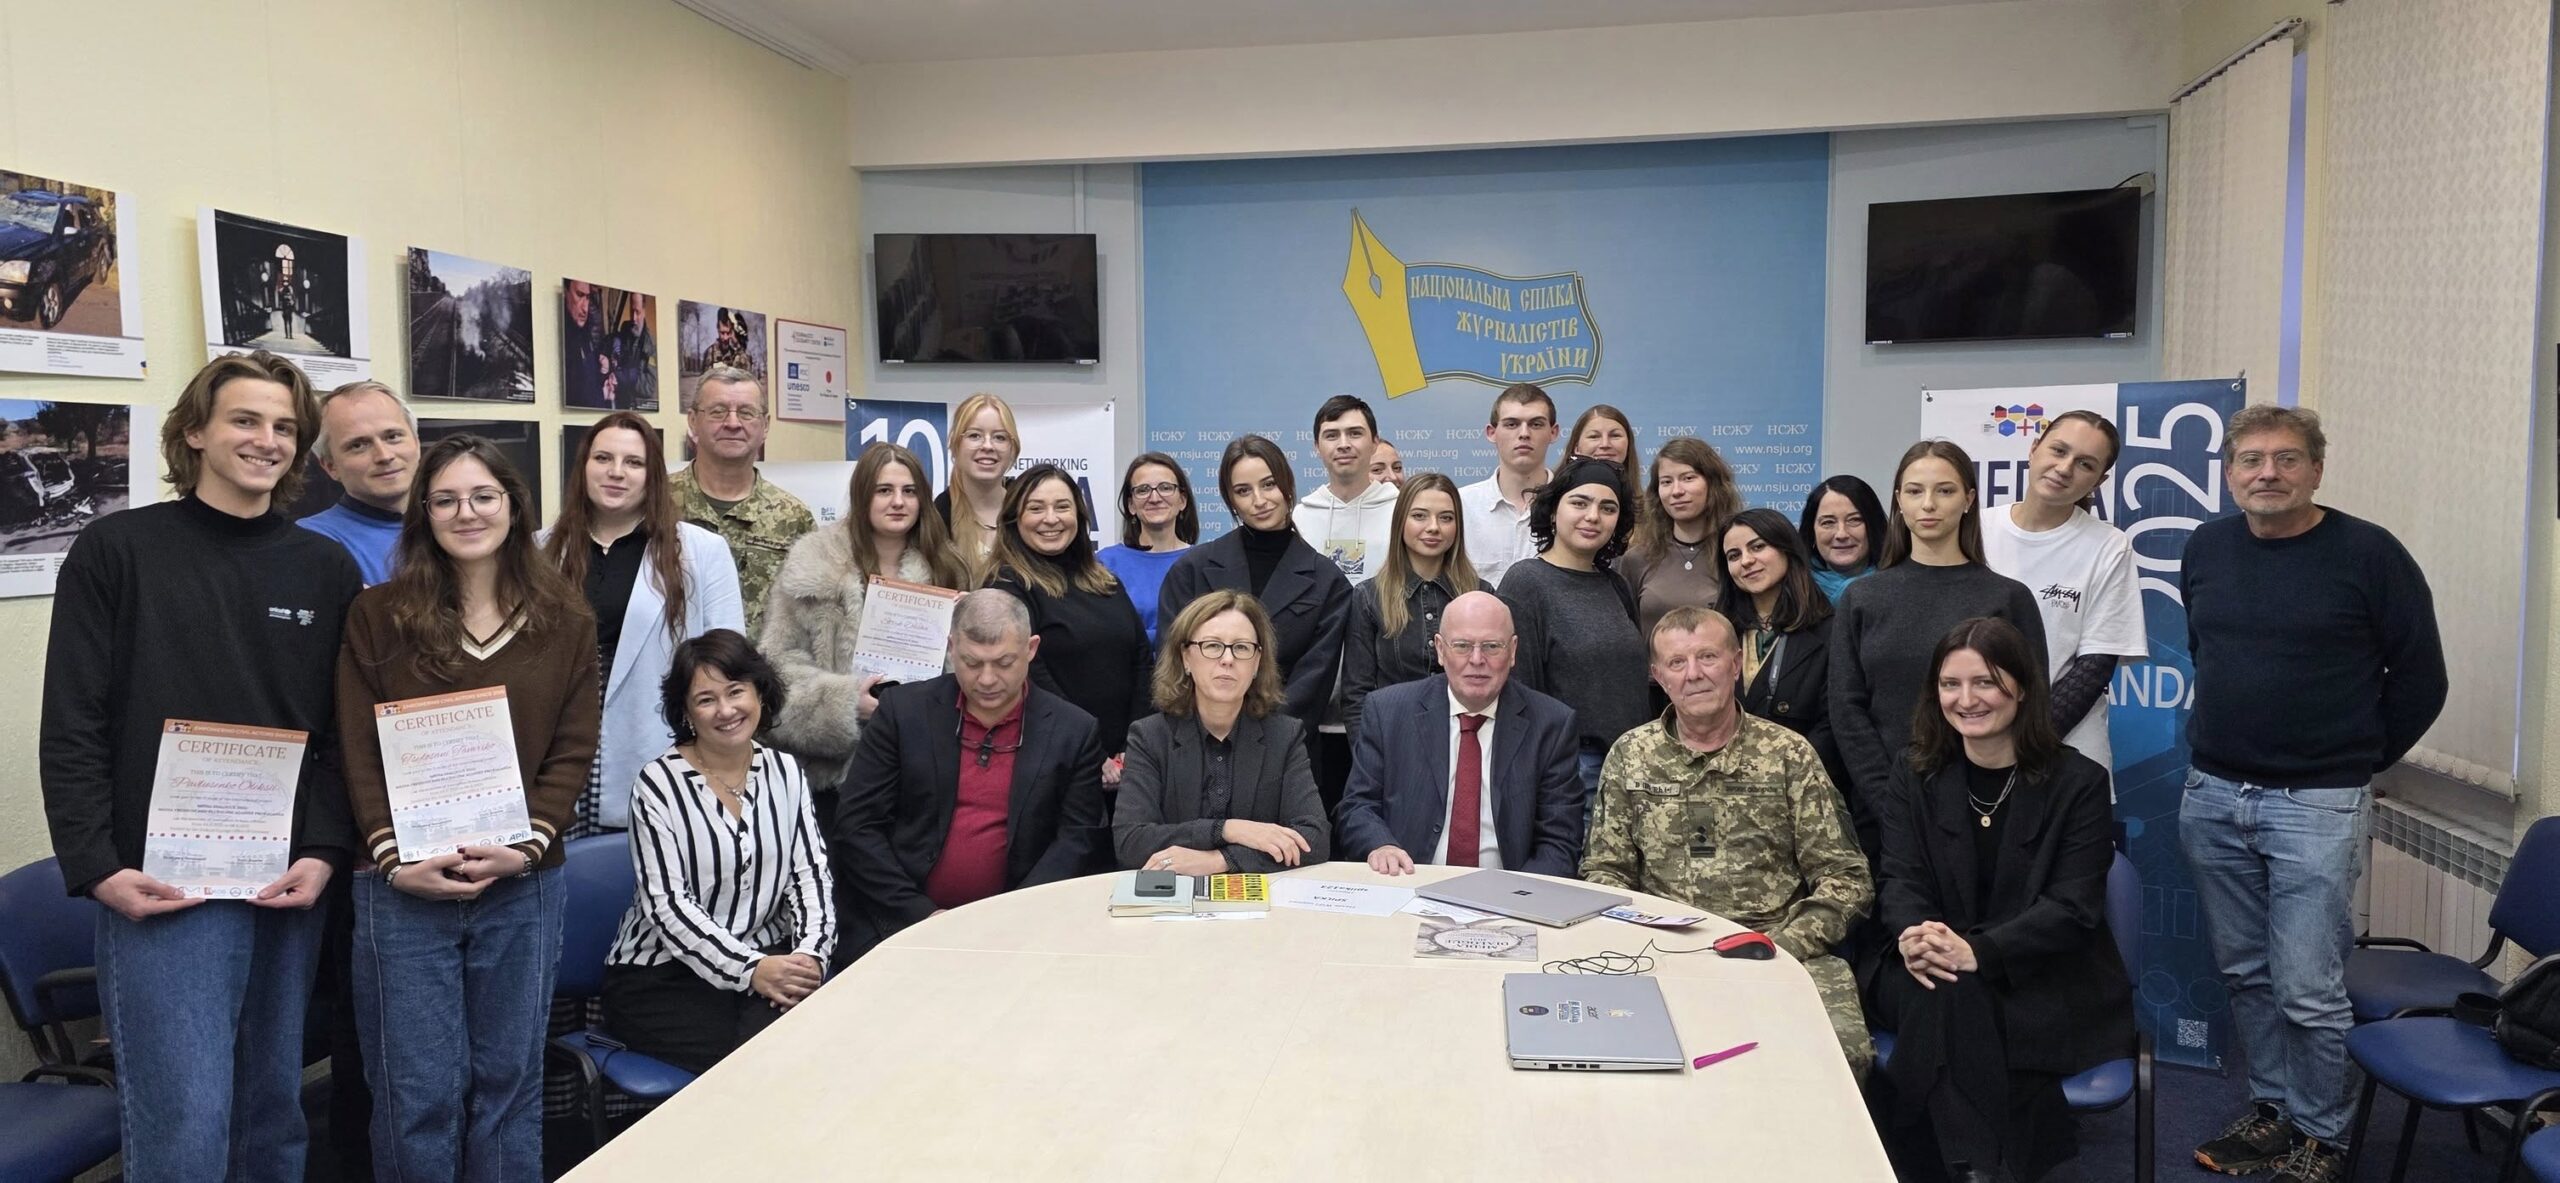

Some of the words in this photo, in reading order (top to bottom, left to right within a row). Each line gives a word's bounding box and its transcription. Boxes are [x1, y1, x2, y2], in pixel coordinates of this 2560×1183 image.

[1410, 274, 1512, 312] НАЦІОНАЛЬНА
[1519, 282, 1576, 312] СПІЛКА
[1456, 310, 1578, 344] ЖУРНАЛІСТІВ
[1501, 346, 1589, 379] УКРАЇНИ
[1151, 431, 1186, 442] НСЖУ
[1198, 431, 1234, 441] НСЖУ
[1396, 429, 1433, 440] НСЖУ
[1446, 428, 1483, 439] НСЖУ
[1657, 426, 1697, 437] НСЖУ
[1712, 425, 1753, 436] НСЖУ
[1767, 424, 1808, 435] НСЖУ
[1735, 443, 1813, 456] www.nsju.org
[1455, 466, 1491, 477] НСЖУ
[1775, 463, 1816, 474] НСЖУ
[876, 588, 945, 611] CERTIFICATE
[394, 705, 495, 732] CERTIFICATE
[178, 739, 287, 760] CERTIFICATE
[1245, 875, 1262, 901] DEFENDING
